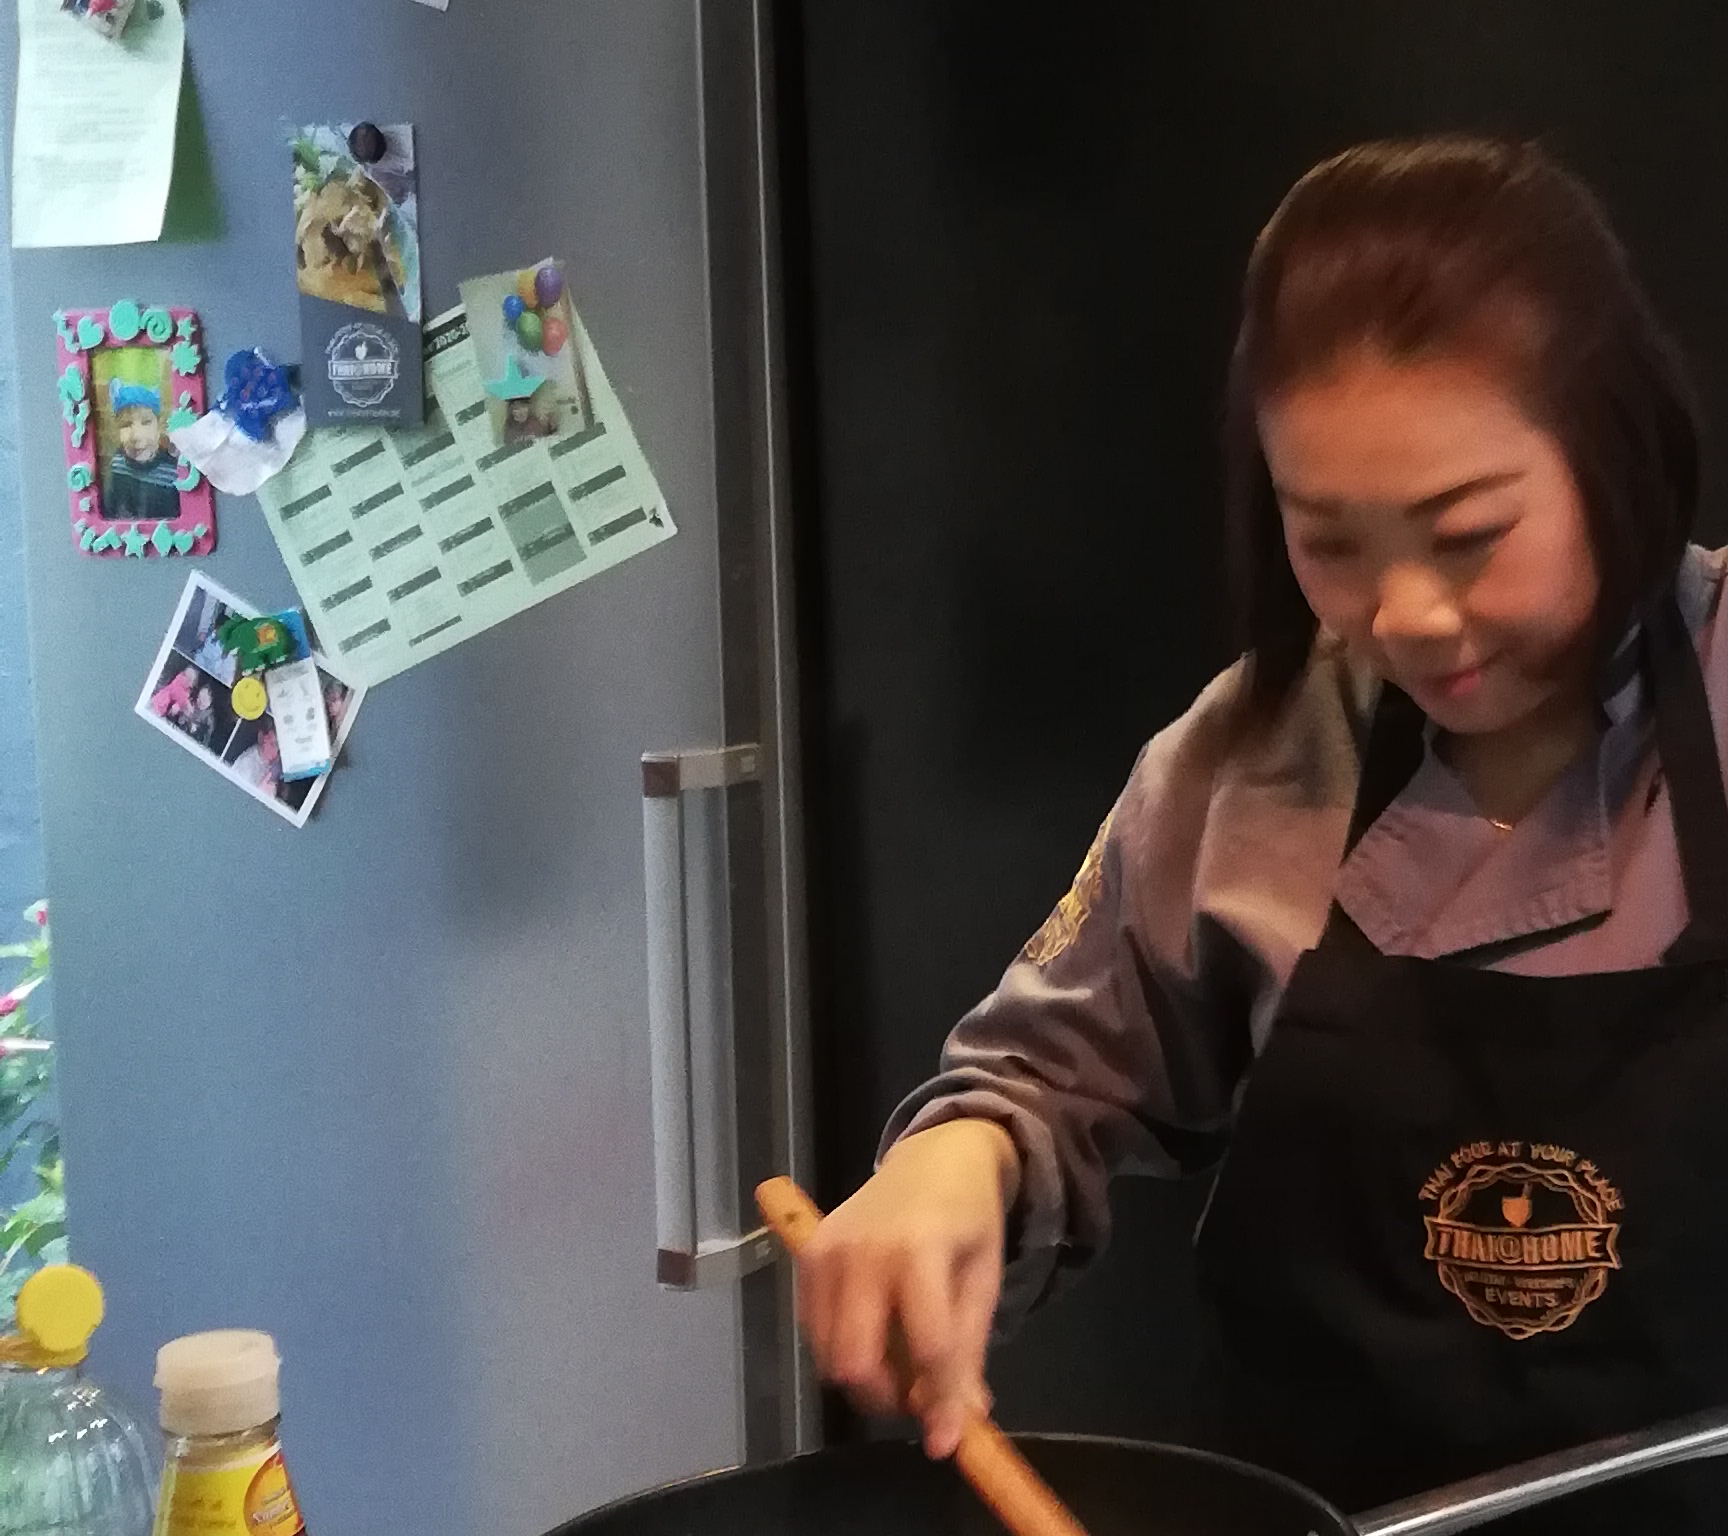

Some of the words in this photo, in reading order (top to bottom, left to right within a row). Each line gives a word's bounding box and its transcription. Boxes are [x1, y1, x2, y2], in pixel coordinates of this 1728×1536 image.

[1498, 1141, 1523, 1157] AT
[1529, 1143, 1578, 1167] YOUR
[1485, 1286, 1559, 1309] EVENTS
